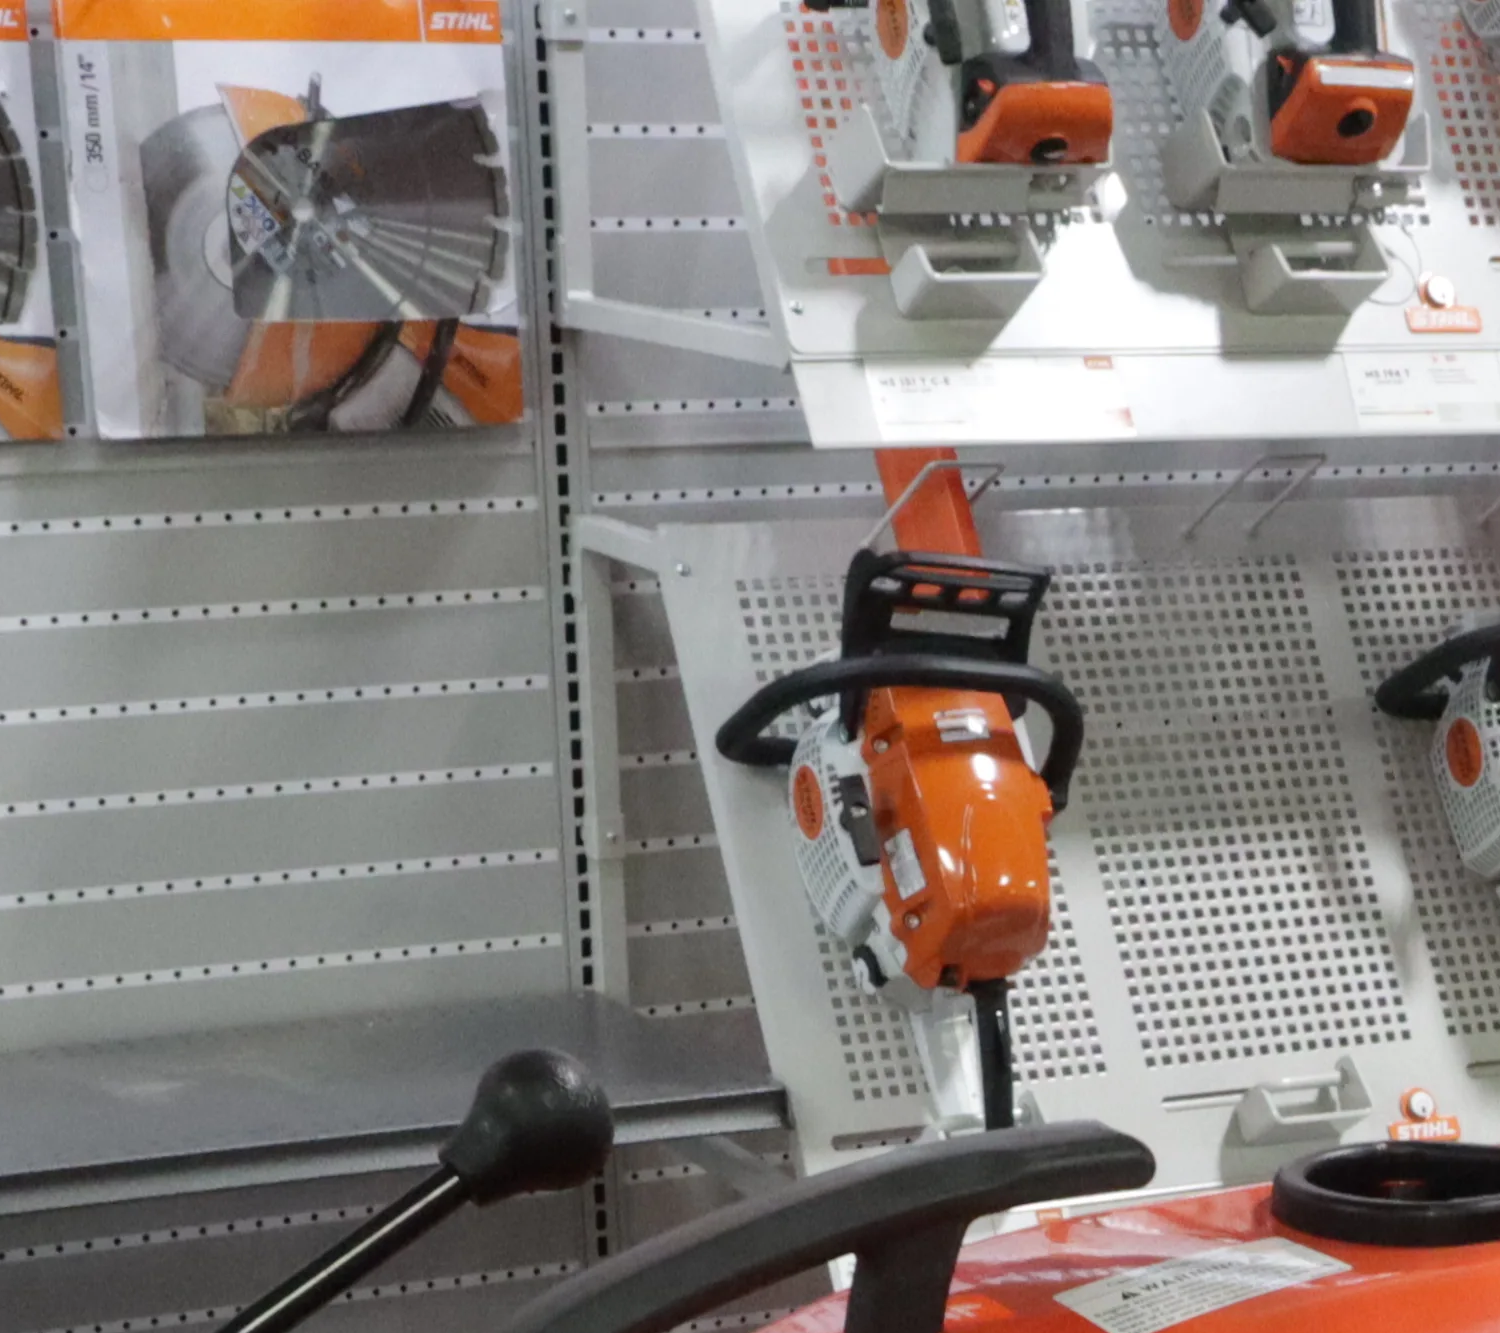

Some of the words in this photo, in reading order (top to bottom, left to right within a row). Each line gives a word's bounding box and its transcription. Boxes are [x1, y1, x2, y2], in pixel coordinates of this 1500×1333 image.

[431, 12, 493, 30] STIHL
[85, 95, 100, 128] mm
[85, 133, 103, 164] 350
[1398, 1119, 1456, 1141] STIHL
